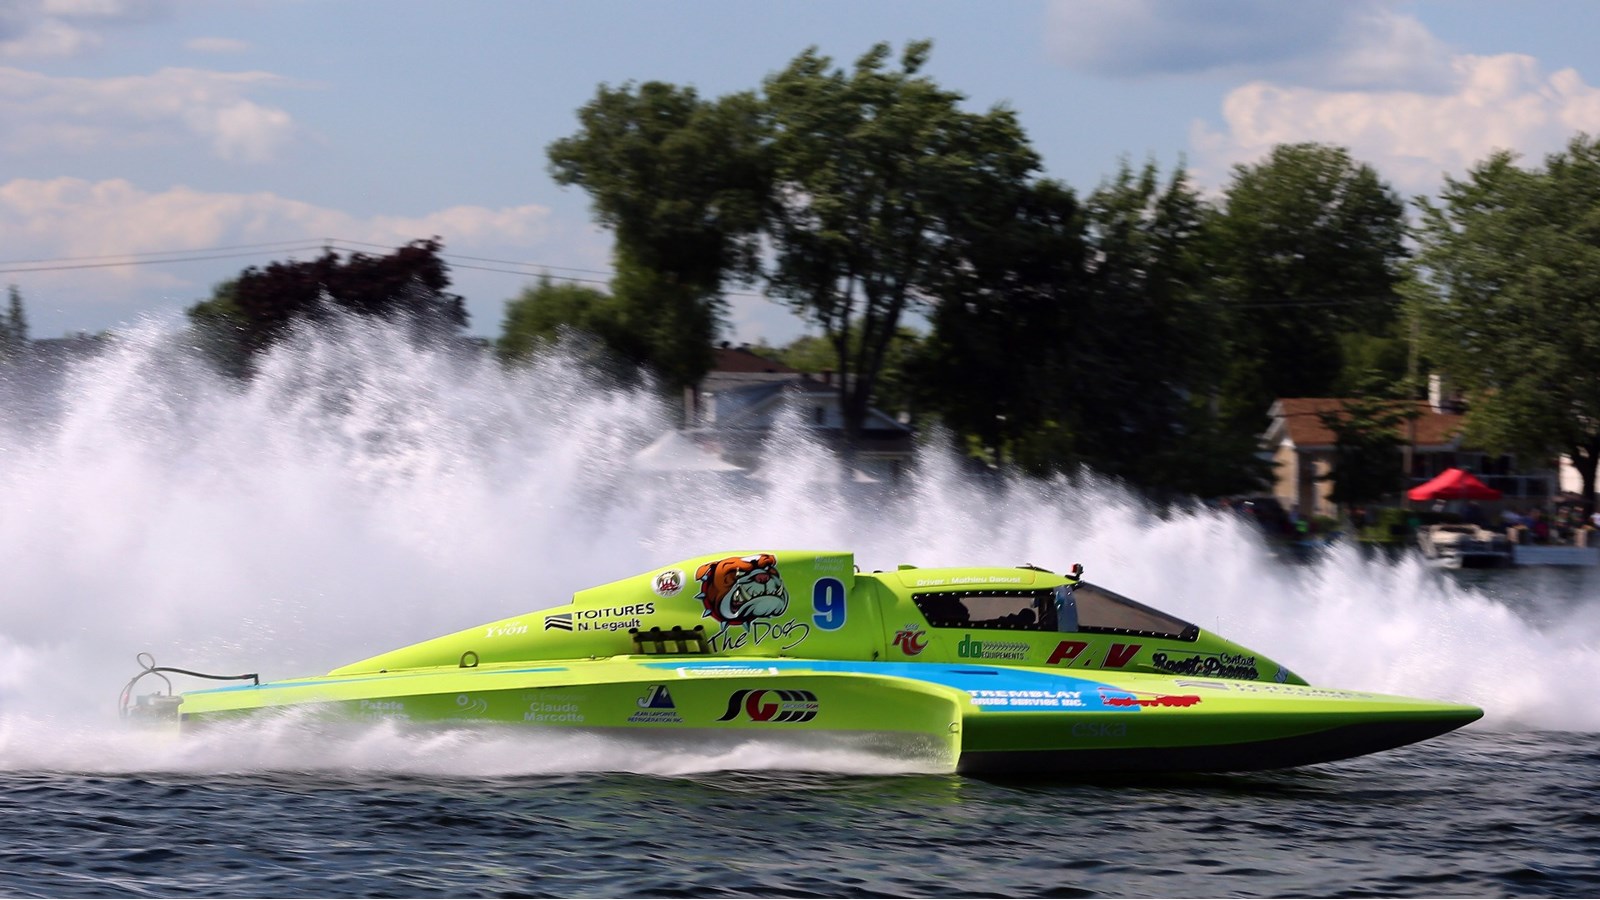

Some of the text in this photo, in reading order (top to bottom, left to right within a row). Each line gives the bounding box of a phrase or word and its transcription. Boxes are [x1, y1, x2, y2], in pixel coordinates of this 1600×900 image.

[915, 579, 945, 587] Driver
[813, 577, 846, 631] 9
[575, 603, 655, 620] TOITURES
[594, 619, 641, 632] Legault
[485, 623, 529, 639] Yvon
[707, 618, 810, 653] The Dog
[981, 651, 1025, 660] EQUIPEMENTS
[1220, 652, 1256, 667] Contact
[967, 690, 1082, 699] TREMBLAY
[360, 700, 404, 710] Patate
[530, 702, 578, 712] Claude
[1010, 698, 1060, 706] SERVICE
[524, 712, 585, 722] Marcotte
